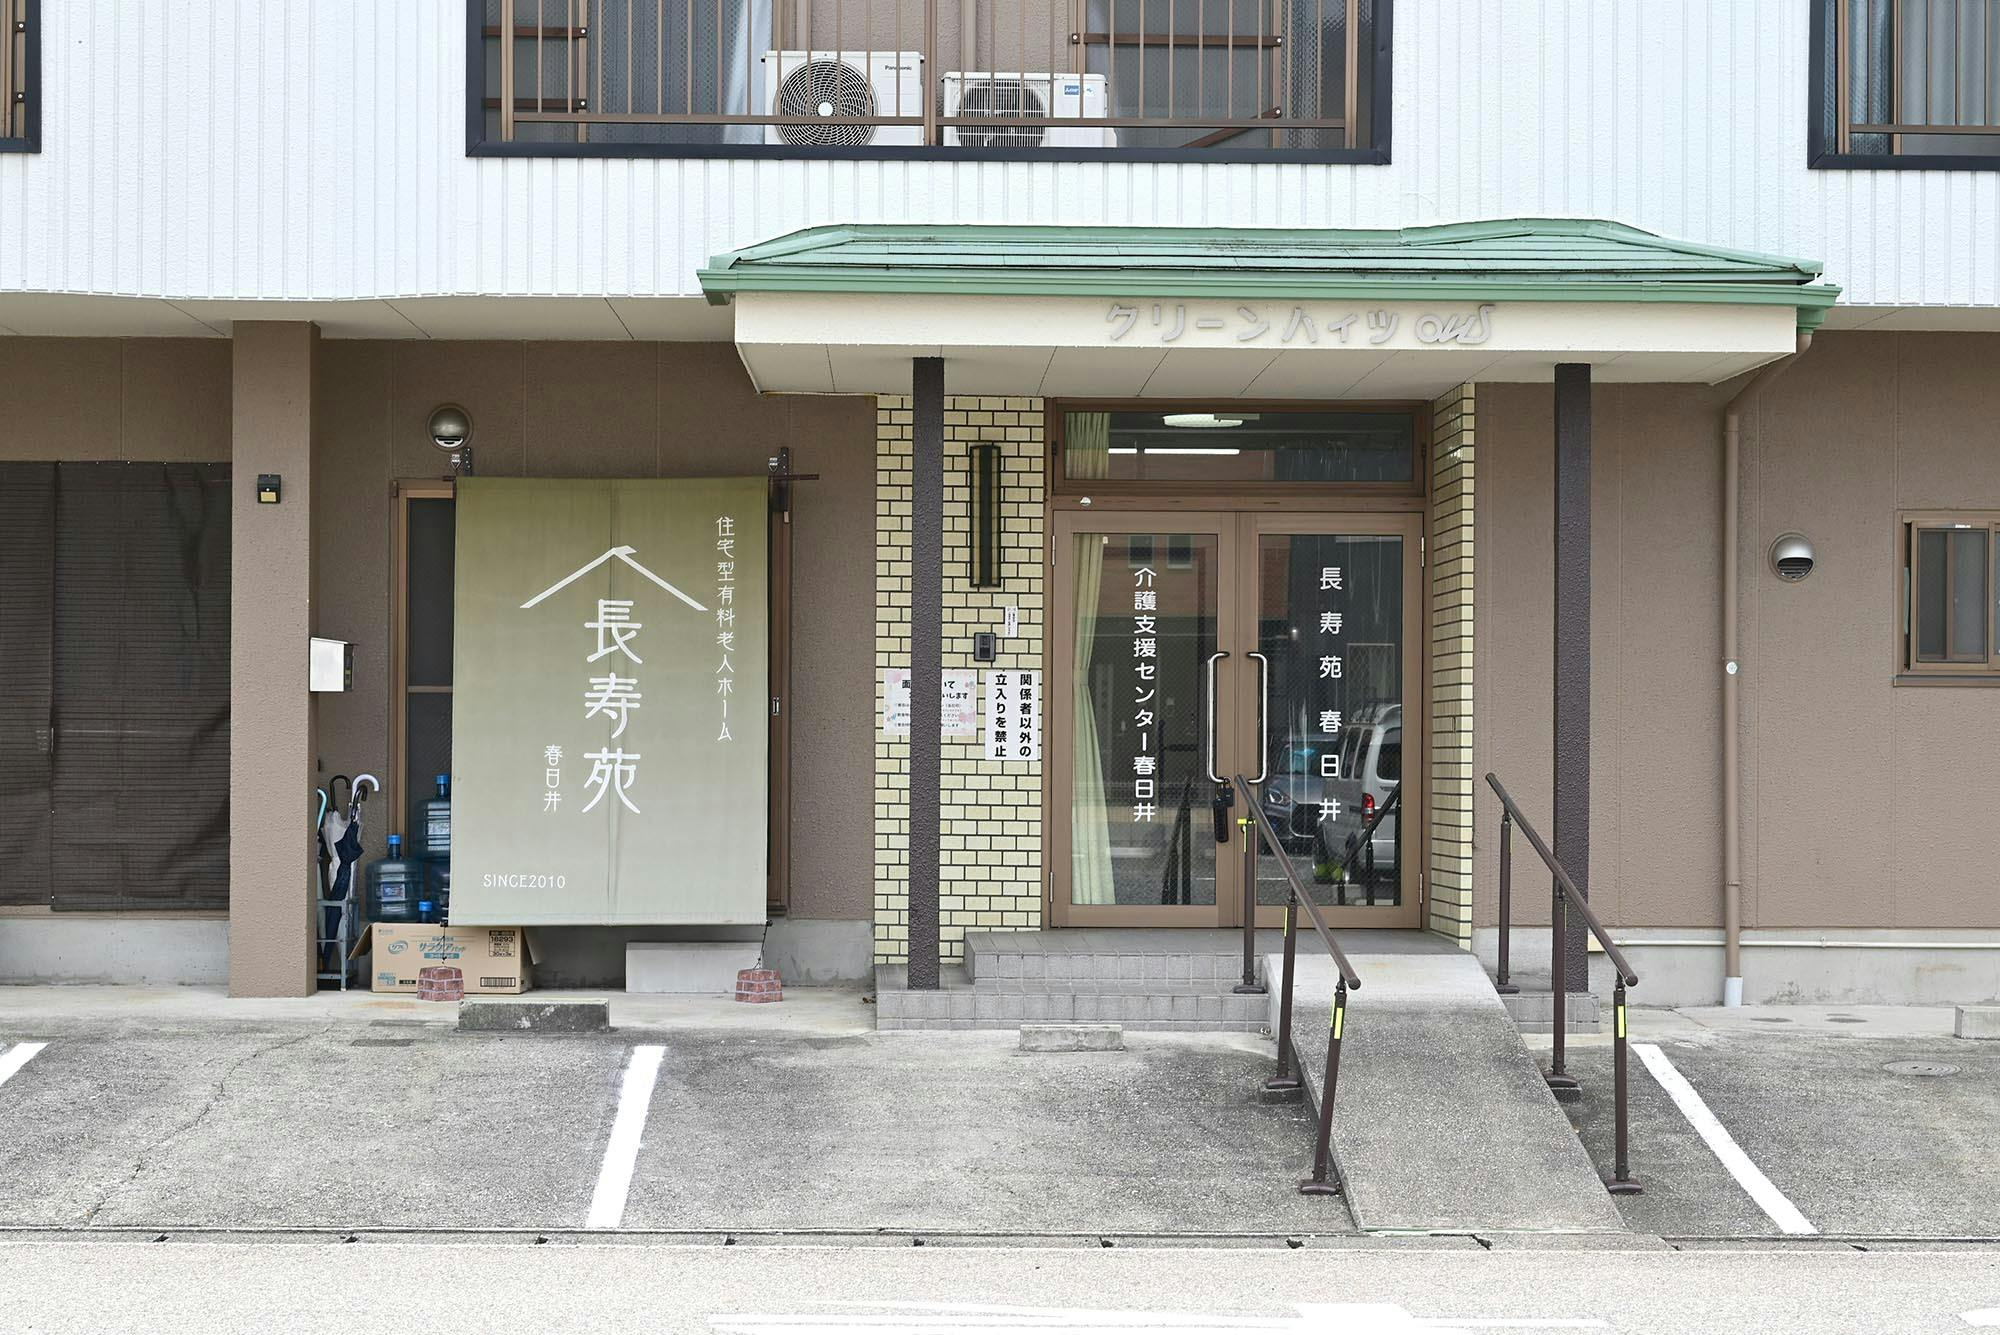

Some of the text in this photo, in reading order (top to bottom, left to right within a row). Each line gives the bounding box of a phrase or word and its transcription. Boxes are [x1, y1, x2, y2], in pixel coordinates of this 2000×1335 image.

[716, 516, 735, 742] 住宅型有料老人ホーム
[1133, 567, 1157, 823] 介護支援センター春日井
[1319, 567, 1343, 822] 長寿苑 春日井
[544, 744, 563, 813] 春日井
[582, 598, 643, 814] 長寿苑
[994, 673, 1008, 758] 立入りを禁止
[1019, 673, 1032, 758] 関係者以外の
[482, 873, 566, 889] SINCE2010
